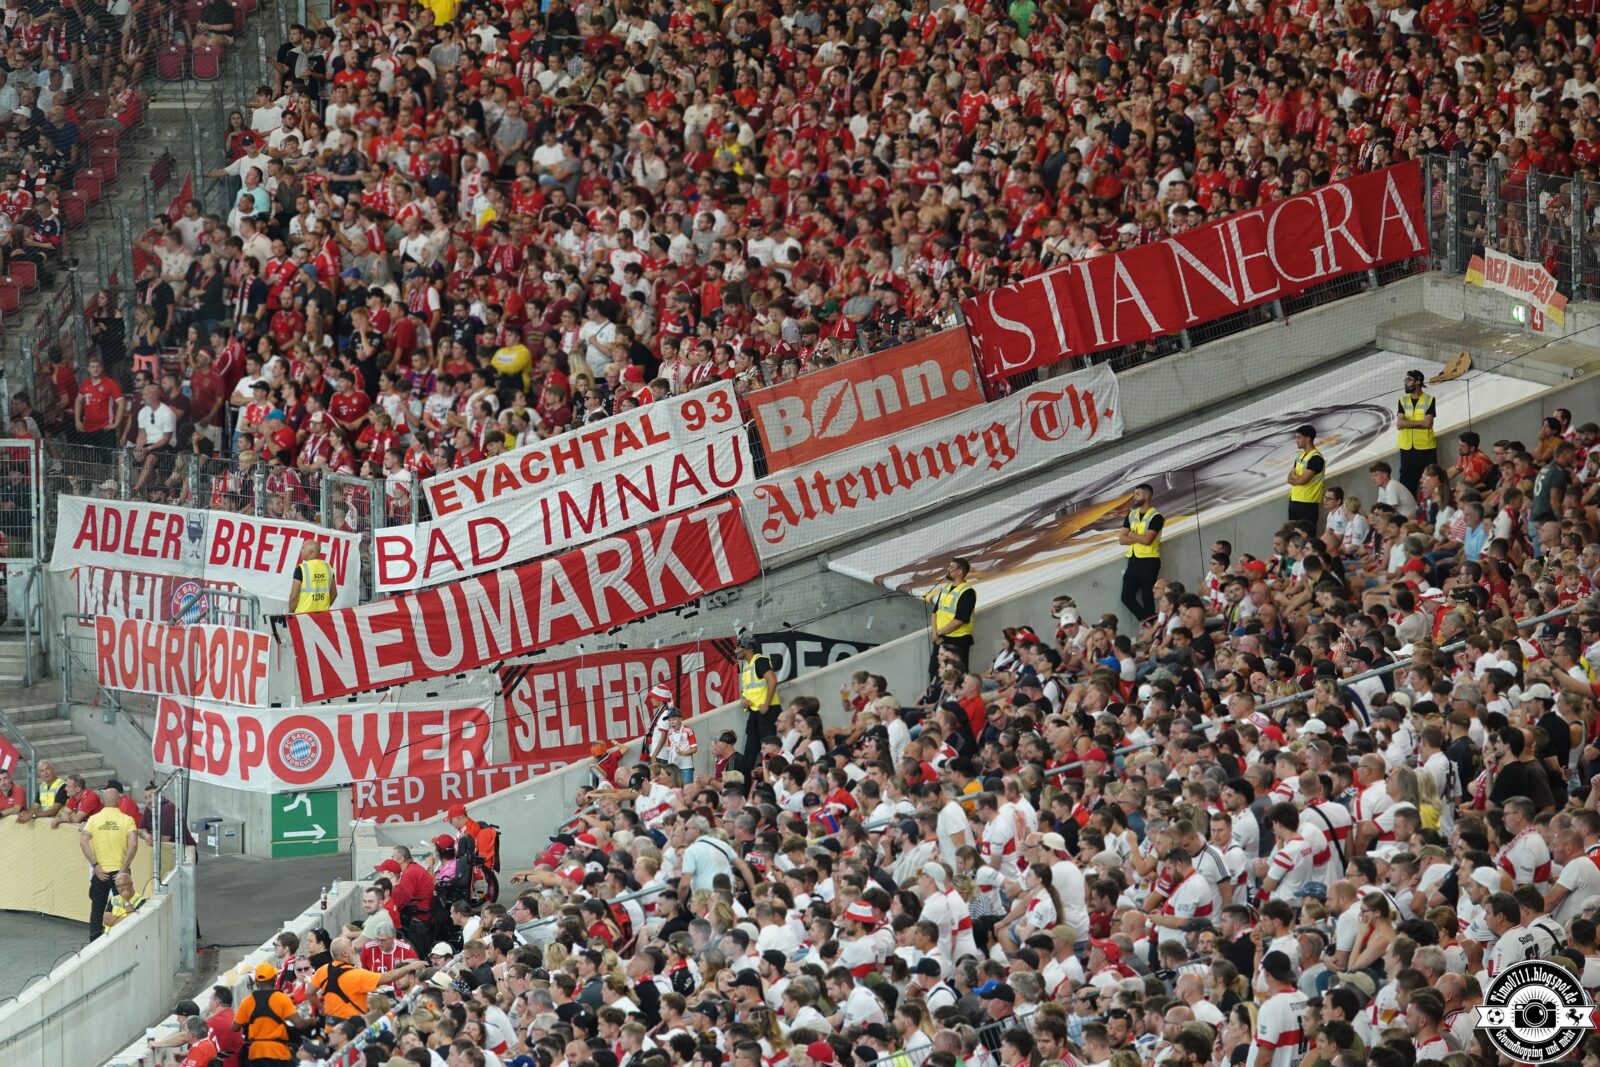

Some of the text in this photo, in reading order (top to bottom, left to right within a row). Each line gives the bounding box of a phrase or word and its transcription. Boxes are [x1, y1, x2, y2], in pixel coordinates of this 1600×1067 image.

[1161, 170, 1424, 323] NEGRA
[1486, 256, 1508, 284] RED
[429, 390, 733, 516] EYACHTAL 93
[73, 505, 184, 560] ADLER
[376, 435, 744, 585] BAD IMNAU
[299, 500, 734, 696] NEUMARKT
[97, 618, 270, 705] ROHRDORF
[154, 698, 490, 784] RED POWER
[291, 733, 316, 747] BAYERN
[357, 776, 424, 808] RED
